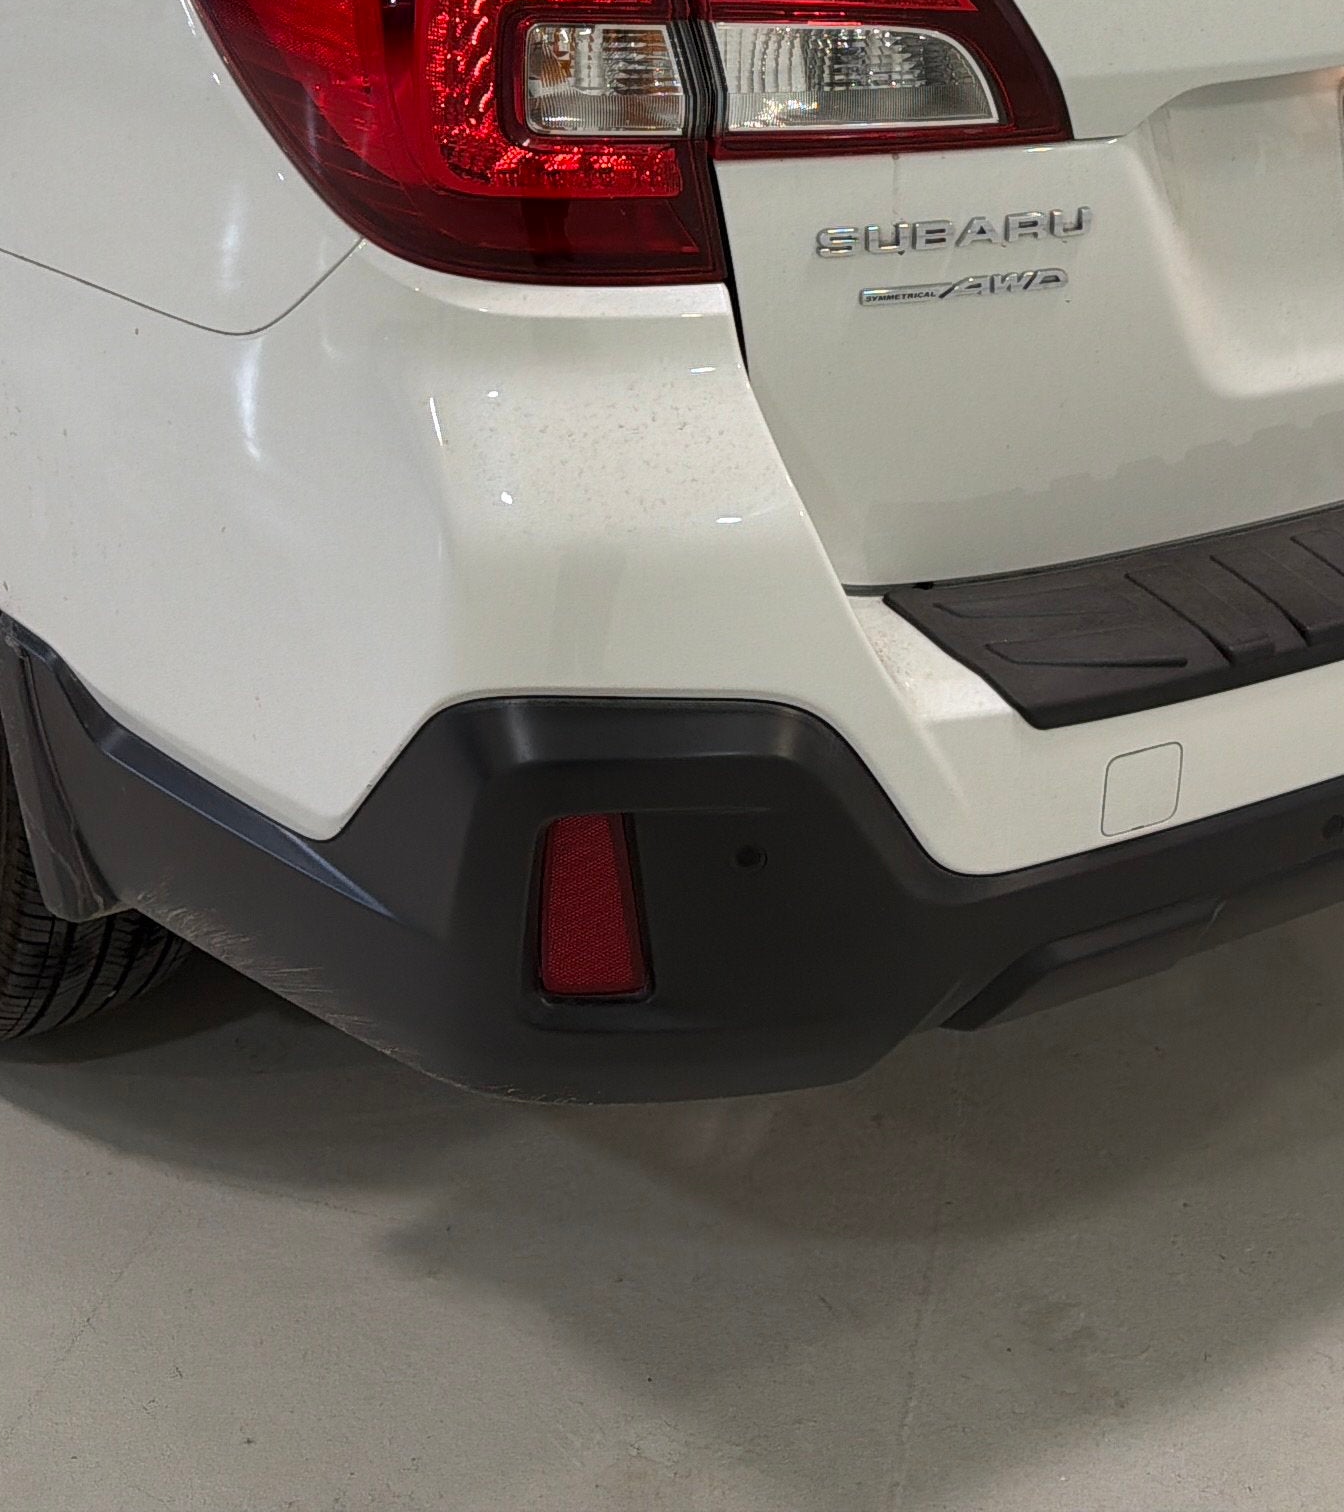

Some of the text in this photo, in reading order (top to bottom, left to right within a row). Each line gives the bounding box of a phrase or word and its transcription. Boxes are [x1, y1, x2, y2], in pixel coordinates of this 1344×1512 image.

[816, 205, 1093, 258] SUBARU
[864, 267, 1069, 303] SYMMETRICAL AWD
